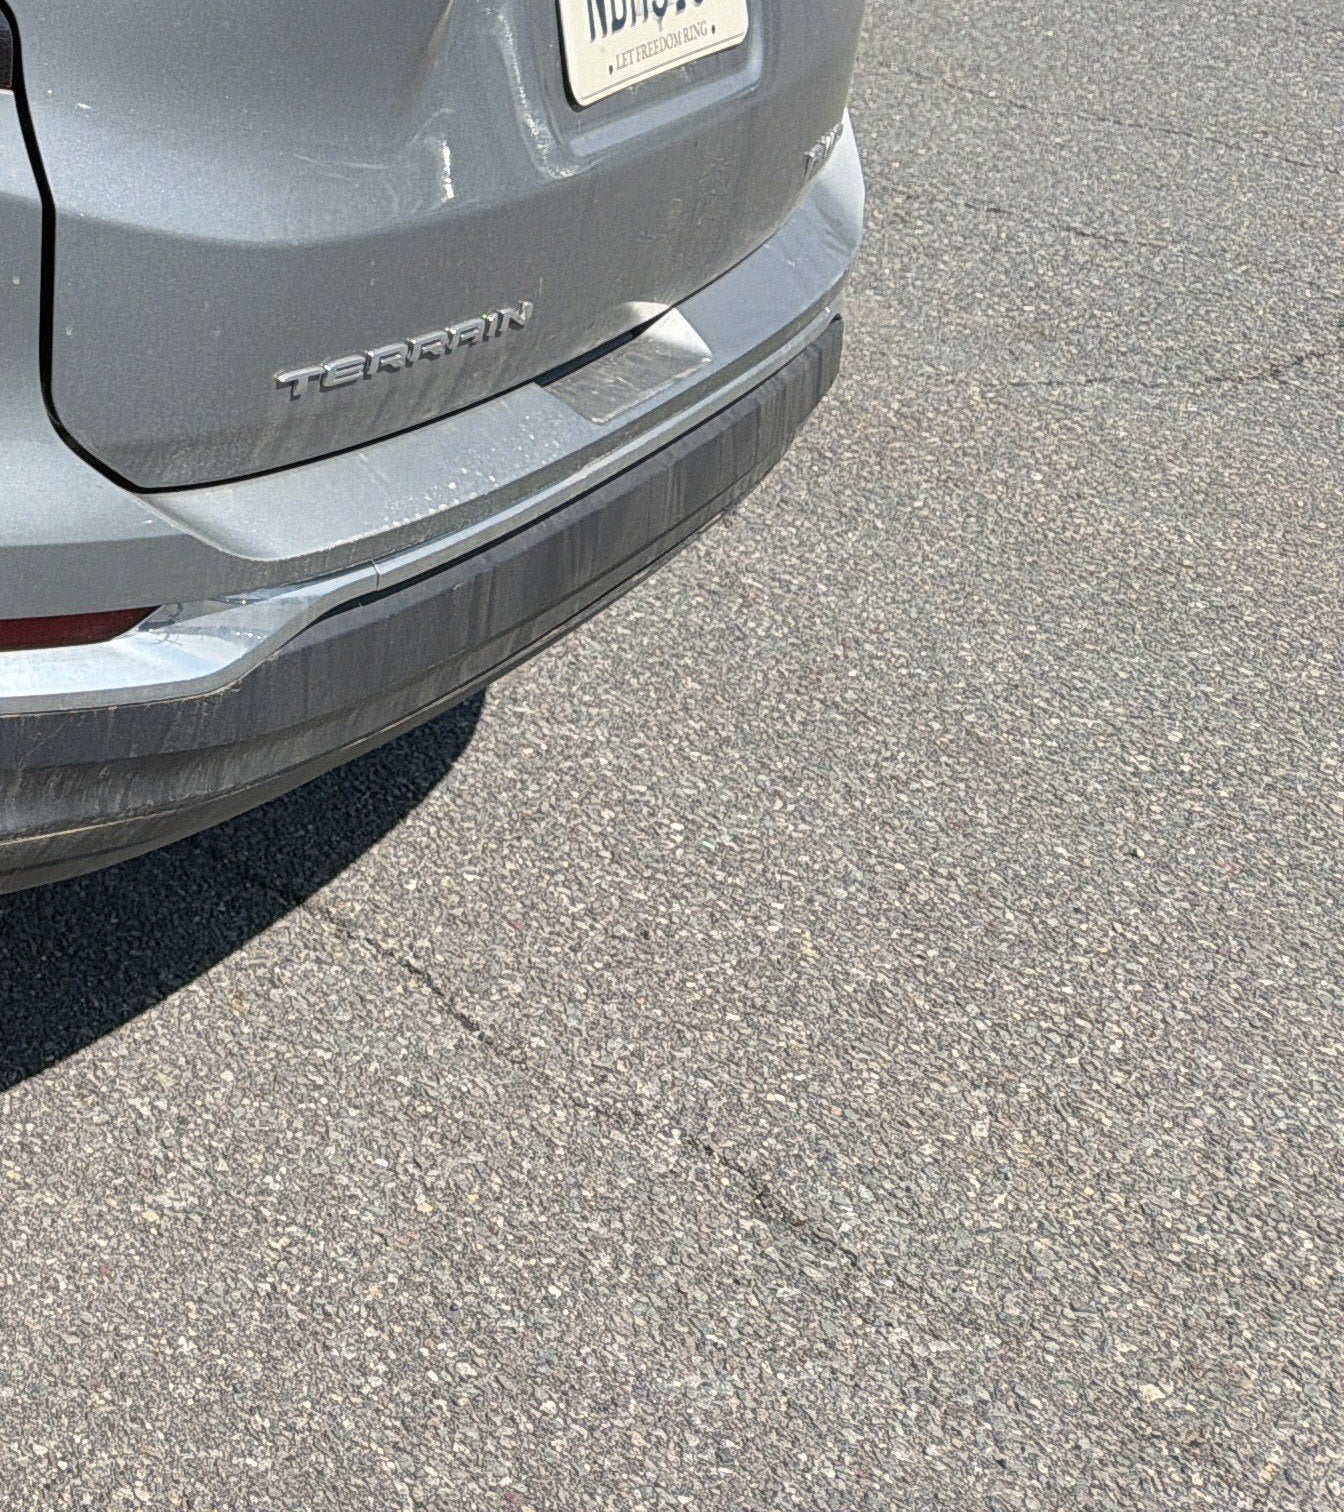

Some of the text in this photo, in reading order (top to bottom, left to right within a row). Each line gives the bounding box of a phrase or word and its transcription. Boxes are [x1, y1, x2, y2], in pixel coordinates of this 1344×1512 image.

[616, 20, 709, 71] LET FREEDOM RING
[273, 298, 534, 397] TERRAIN
